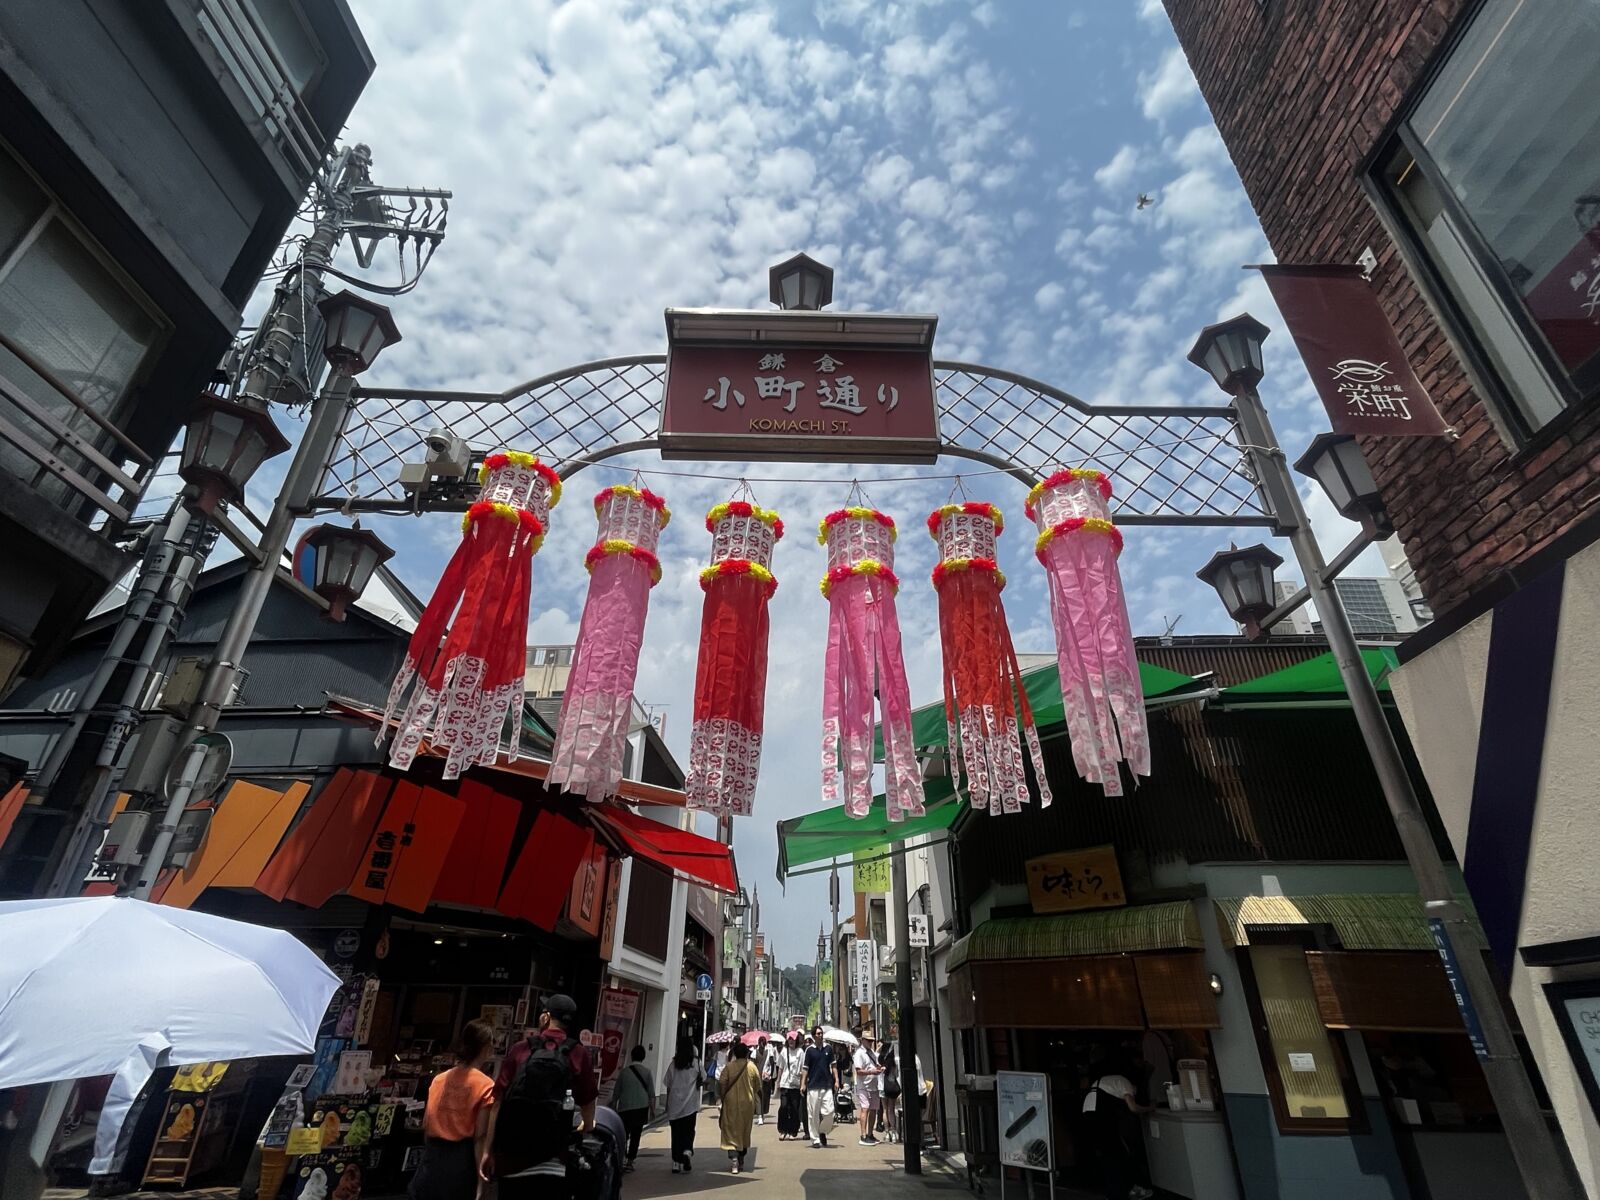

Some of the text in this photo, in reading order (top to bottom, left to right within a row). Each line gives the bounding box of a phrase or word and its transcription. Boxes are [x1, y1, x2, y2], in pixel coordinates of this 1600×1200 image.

[757, 352, 844, 373] 鎌倉
[703, 375, 899, 416] 小町通り
[1337, 383, 1412, 420] 栄町
[749, 418, 852, 432] KOMACHI ST.
